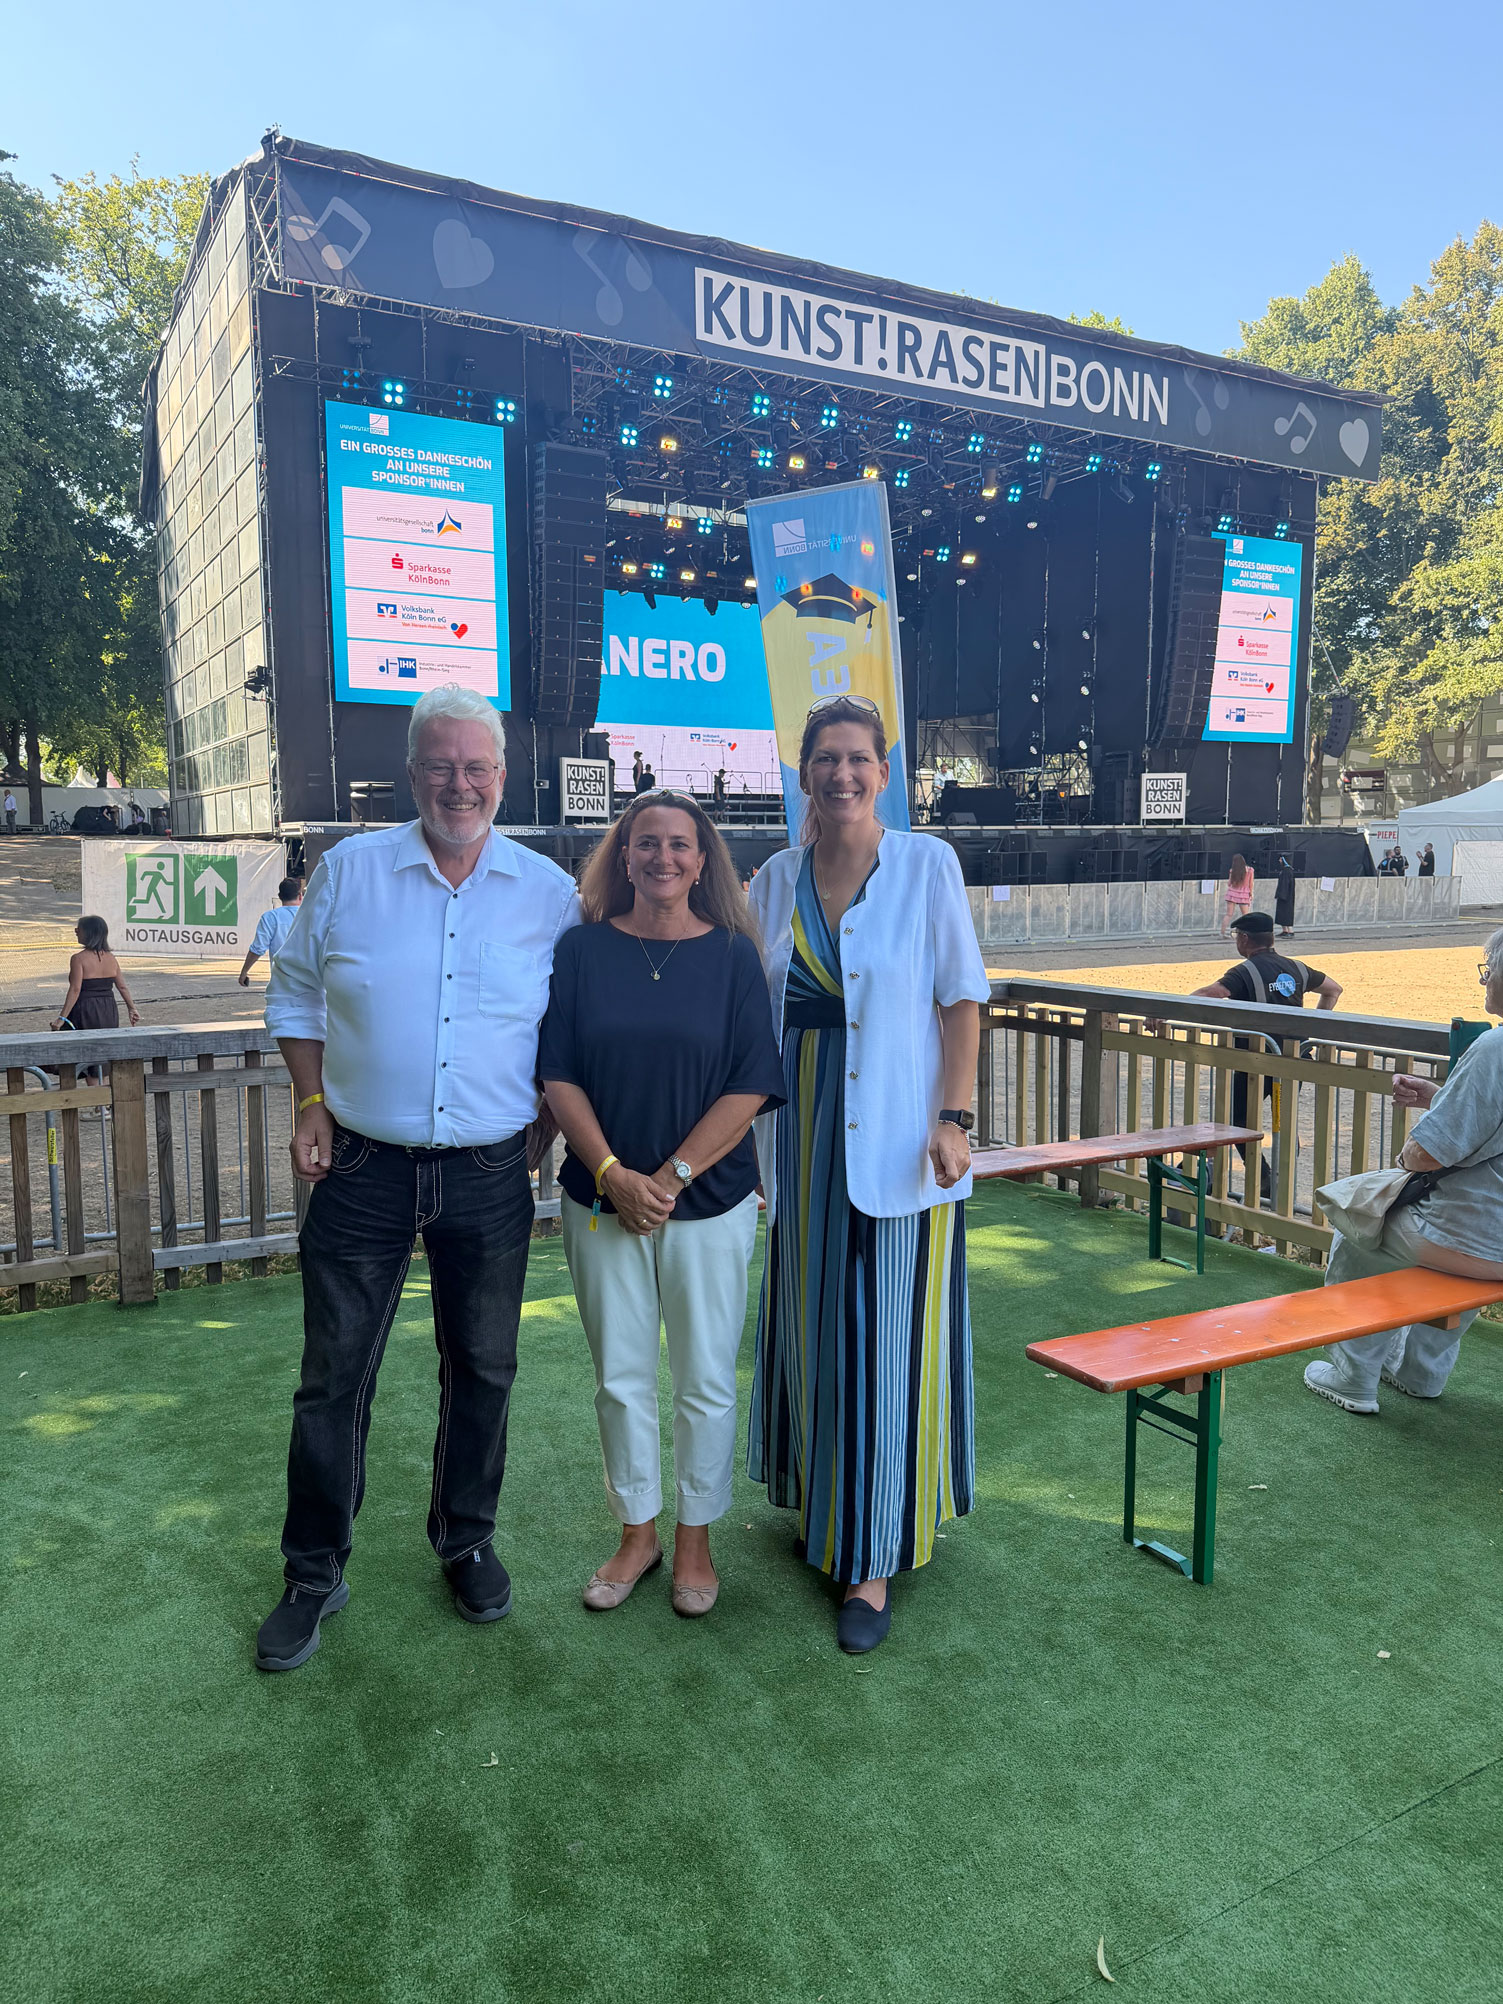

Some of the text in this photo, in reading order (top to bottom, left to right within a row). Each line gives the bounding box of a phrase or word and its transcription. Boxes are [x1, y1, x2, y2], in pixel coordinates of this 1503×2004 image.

[1051, 354, 1169, 426] BONN
[340, 439, 492, 470] EIN GROSSES DANKESCHÖN
[386, 459, 450, 478] AN UNSERE
[408, 562, 452, 575] Sparkasse
[1229, 559, 1255, 570] GROSSES
[408, 573, 450, 586] KölnBonn
[1240, 570, 1273, 581] AN UNSERE
[401, 605, 435, 614] Volksbank
[399, 660, 416, 669] IHK
[567, 766, 605, 781] KUNST!
[569, 780, 603, 795] RASEN
[1146, 779, 1182, 790] KUNST!
[1148, 790, 1180, 801] RASEN
[568, 796, 605, 812] BONN
[1146, 803, 1181, 814] BONN
[303, 826, 324, 834] BONN
[125, 928, 238, 945] NOTAUSGANG
